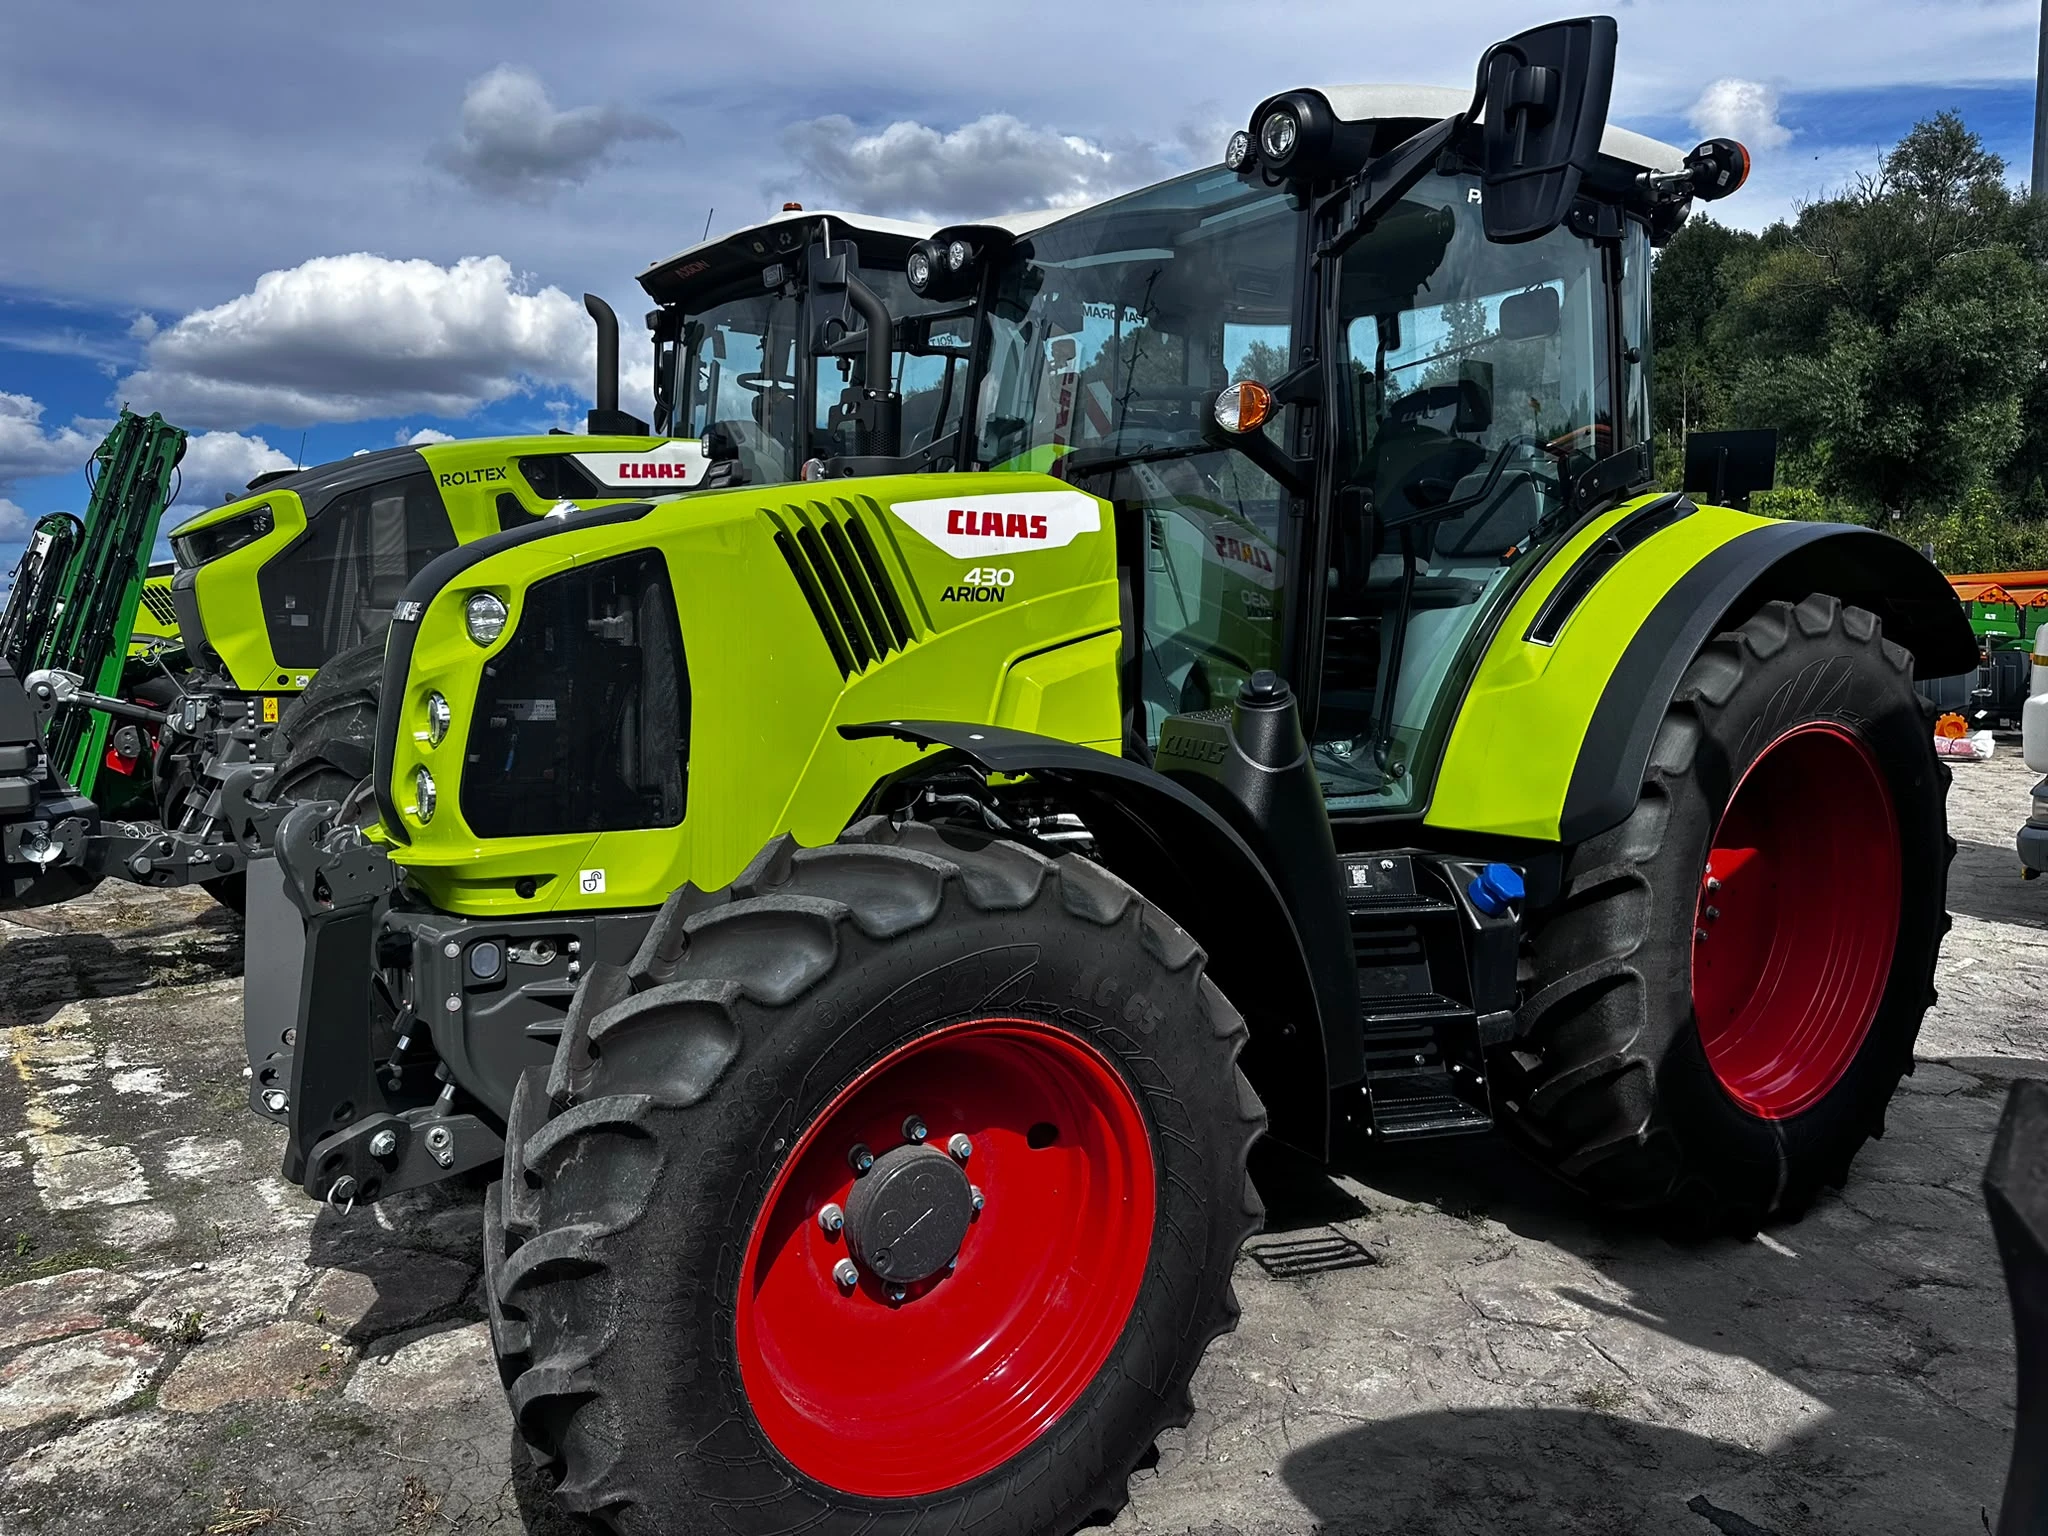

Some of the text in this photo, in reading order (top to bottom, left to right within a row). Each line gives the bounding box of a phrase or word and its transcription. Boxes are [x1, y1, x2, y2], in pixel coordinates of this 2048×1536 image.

[440, 467, 507, 487] ROLTEX
[619, 463, 686, 478] CLAAS
[947, 510, 1047, 539] CLAAS
[963, 567, 1014, 586] 430
[940, 586, 1005, 602] ARION
